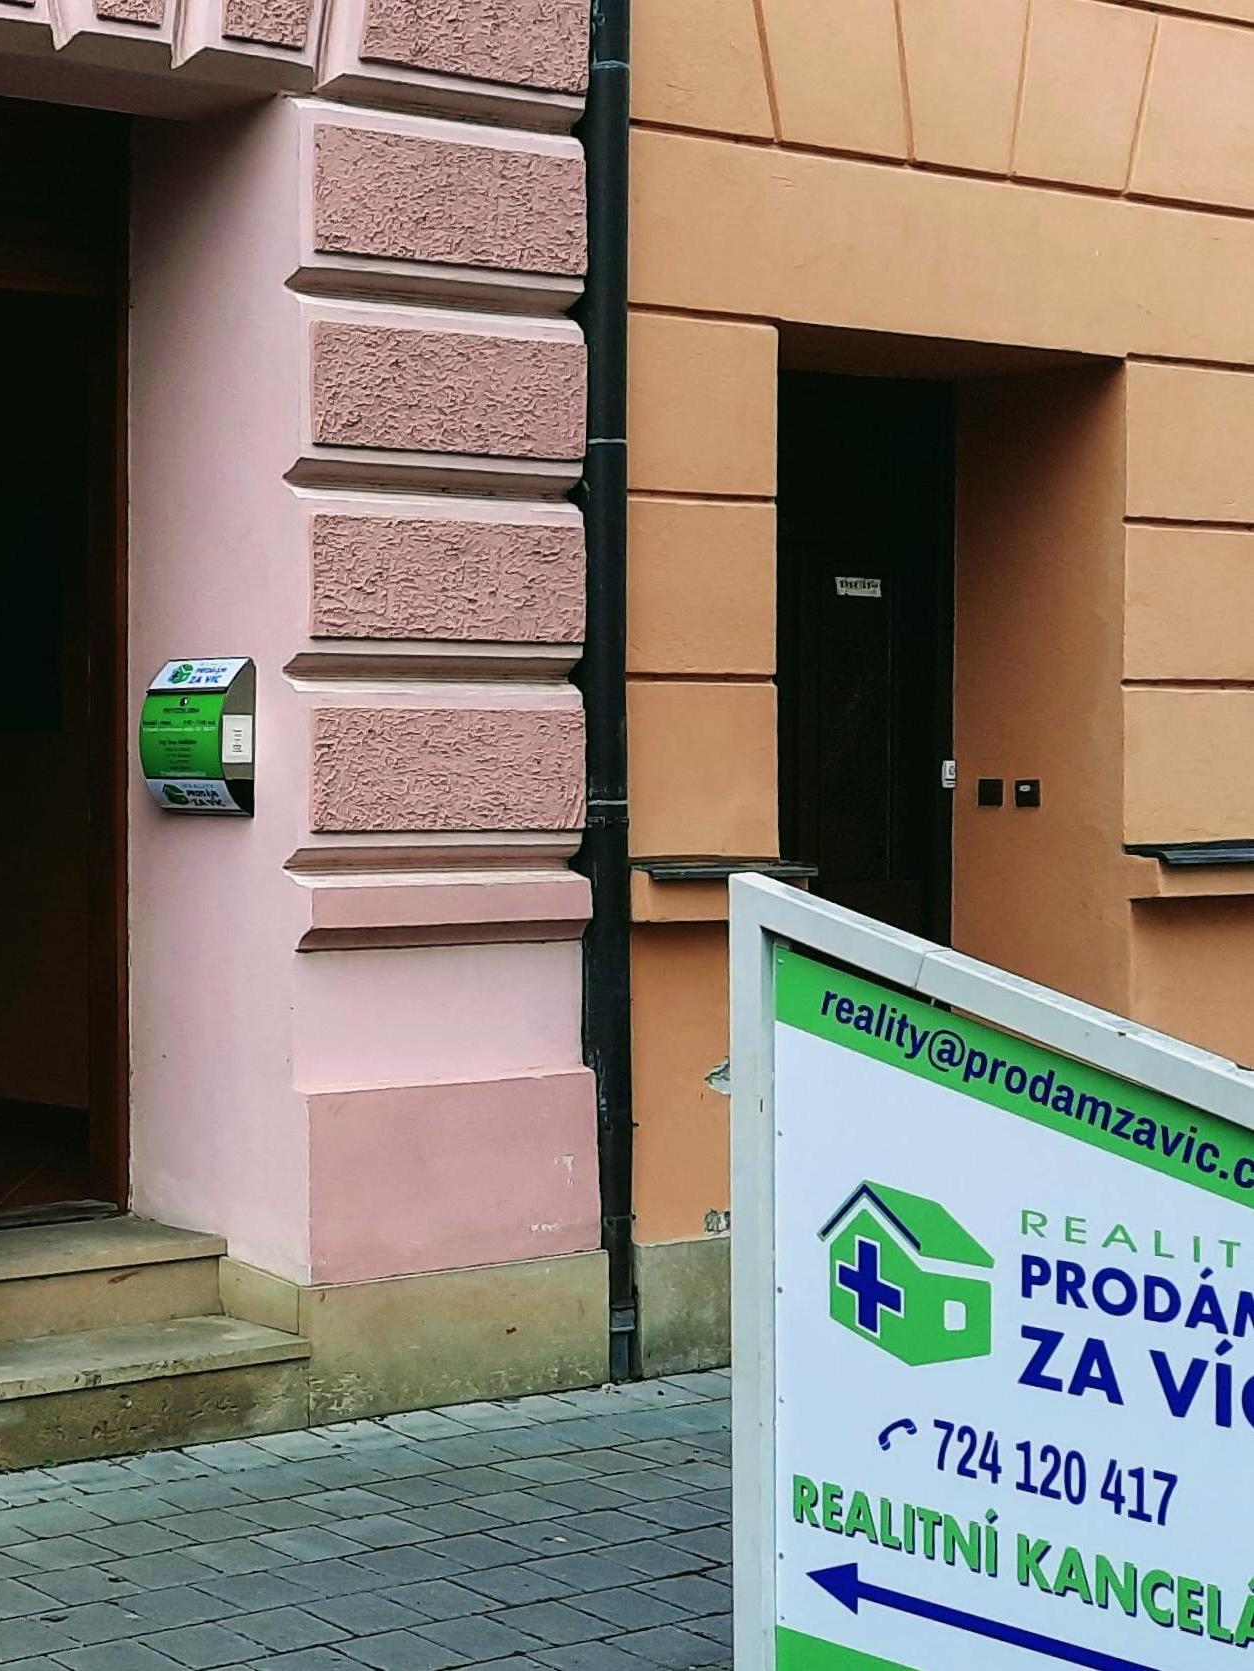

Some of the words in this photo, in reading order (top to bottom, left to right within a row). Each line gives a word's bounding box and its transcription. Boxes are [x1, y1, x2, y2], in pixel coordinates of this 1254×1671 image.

[820, 989, 1254, 1189] reality@prodamzavic.c
[1021, 1209, 1242, 1268] REALIT
[1017, 1324, 1125, 1406] ZA
[1148, 1338, 1254, 1429] VÍ
[933, 1418, 1002, 1484] 724
[1015, 1440, 1087, 1506] 120
[1100, 1458, 1178, 1526] 417
[792, 1473, 998, 1577] REALITNÍ
